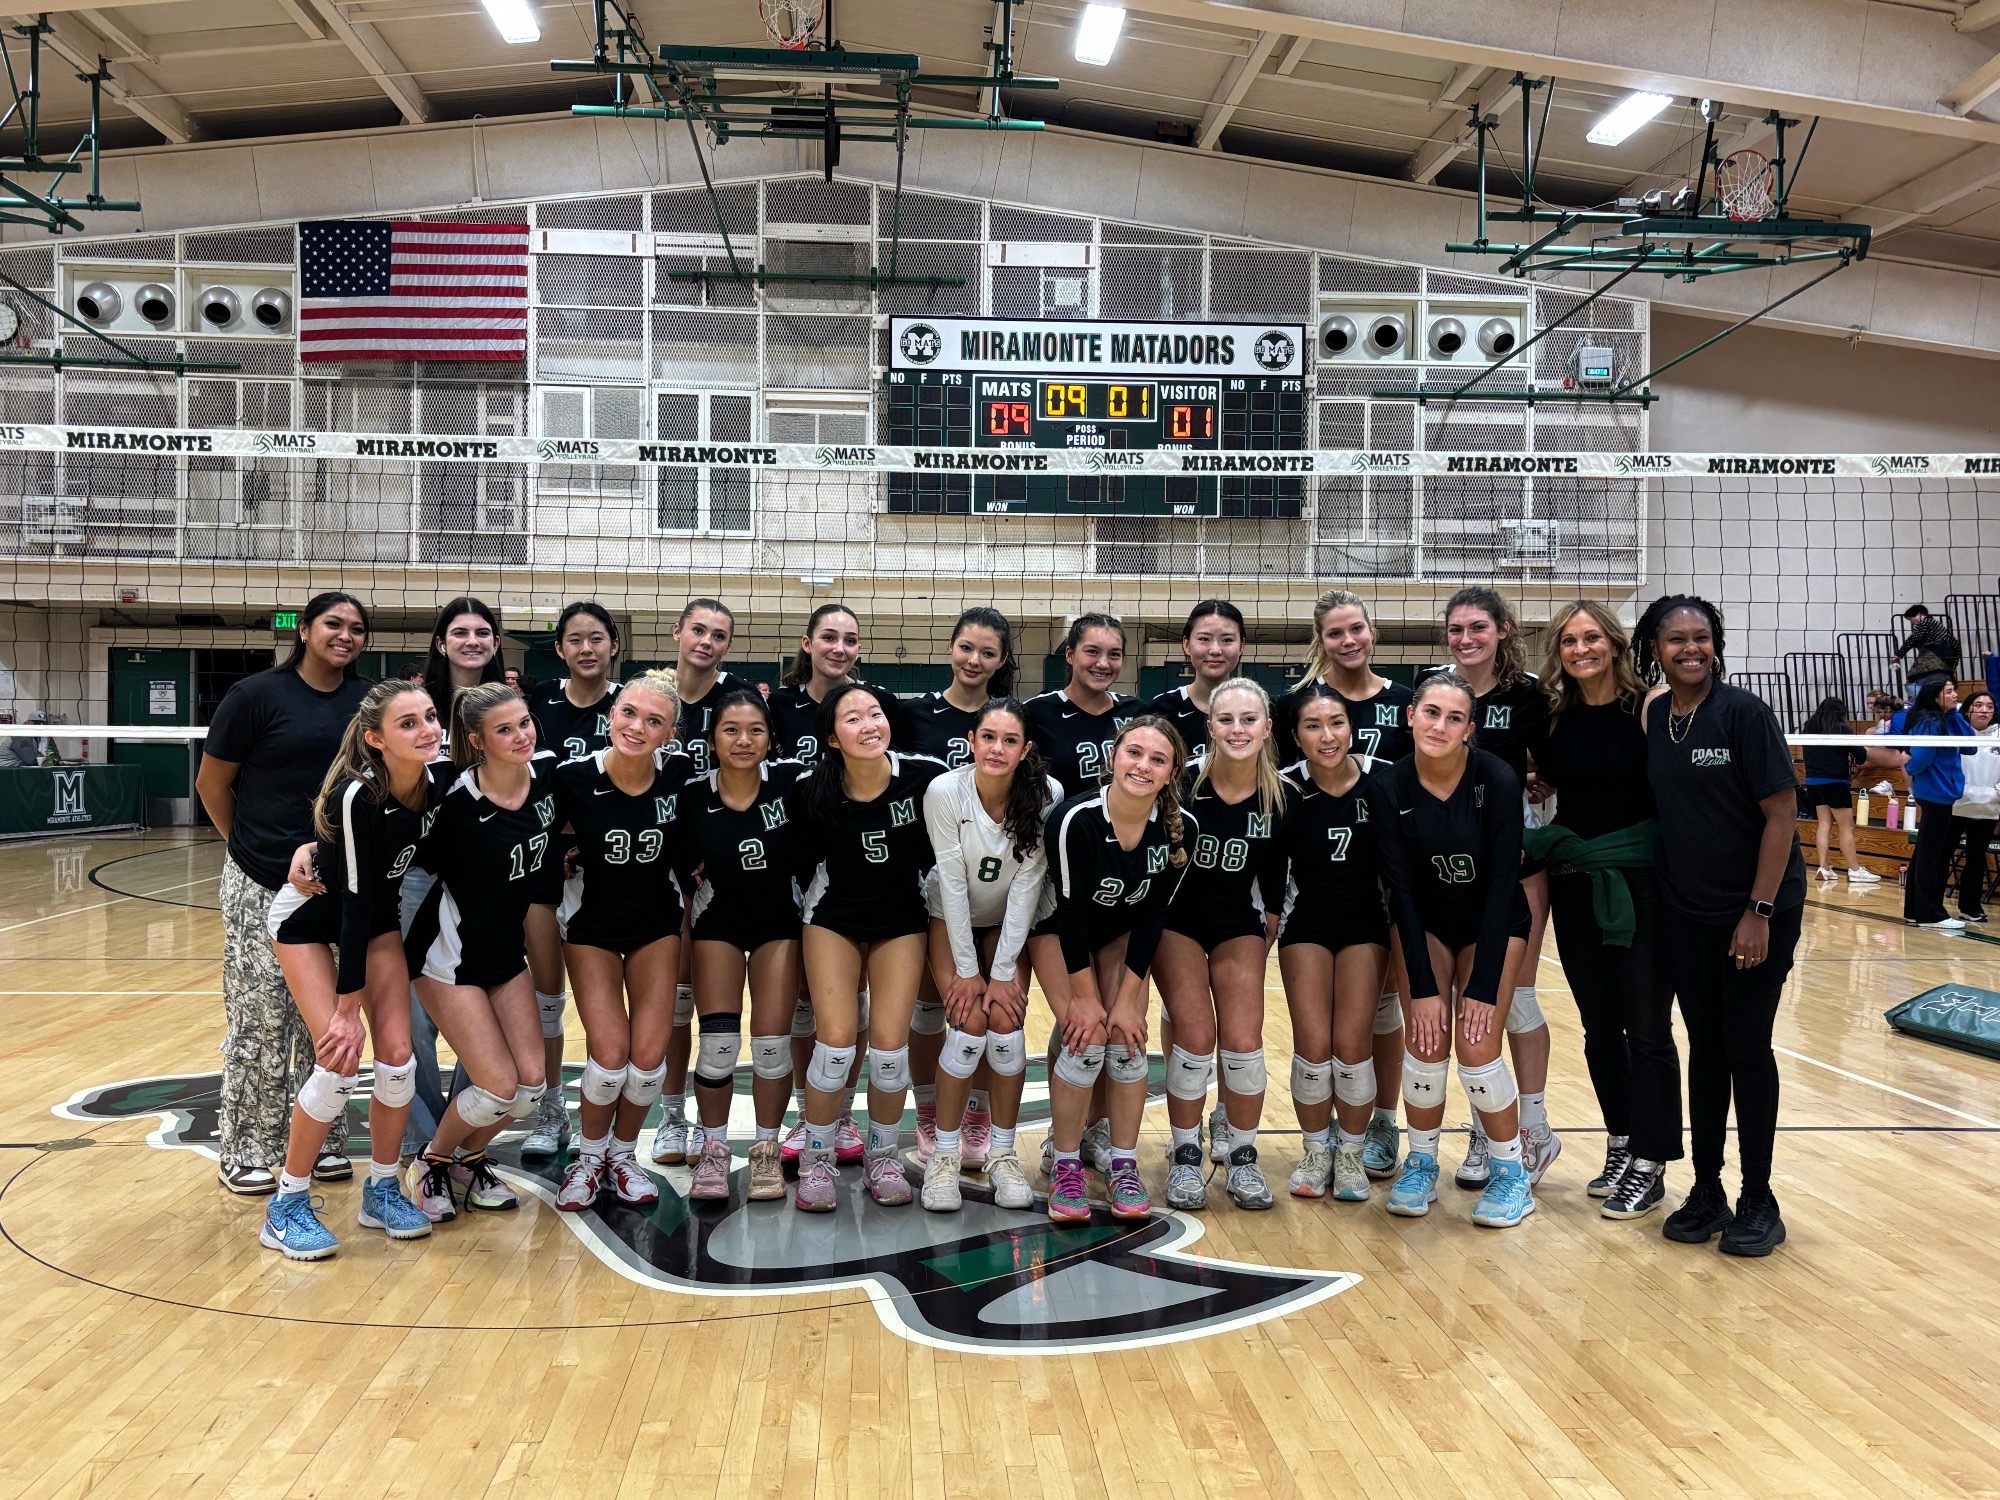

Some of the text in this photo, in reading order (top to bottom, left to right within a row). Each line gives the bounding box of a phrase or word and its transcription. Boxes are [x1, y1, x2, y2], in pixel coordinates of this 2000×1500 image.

[915, 339, 941, 347] MATS
[960, 330, 1102, 363] MIRAMONTE
[1110, 333, 1235, 366] MATADORS
[890, 373, 962, 385] NO F PTS
[1230, 379, 1301, 391] NO F PTS
[982, 382, 1031, 397] MATS
[1161, 385, 1217, 400] VISITOR
[991, 403, 1029, 435] 09
[1075, 425, 1097, 433] POSS
[1173, 407, 1211, 437] 01
[67, 431, 212, 452] MIRAMONTE
[273, 434, 316, 447] MATS
[356, 439, 497, 458] MIRAMONTE
[557, 441, 599, 454] MATS
[1066, 435, 1106, 446] PERIOD
[638, 445, 777, 465] MIRAMONTE
[834, 447, 876, 460] MATS
[913, 452, 1048, 471] MIRAMONTE
[1104, 452, 1144, 464] MATS
[1181, 455, 1314, 471] MIRAMONTE
[1369, 453, 1410, 465] MATS
[1632, 455, 1672, 467] MATS
[1890, 456, 1929, 468] MATS
[1447, 456, 1578, 473] MIRAMONTE
[1707, 458, 1836, 474] MIRAMONTE
[986, 502, 1008, 512] WON
[1173, 505, 1195, 514] WON
[275, 613, 297, 629] EXIT
[1374, 703, 1400, 728] M
[1484, 705, 1512, 730] M
[1349, 728, 1382, 757] 7
[1691, 748, 1732, 764] COACH
[52, 770, 86, 816] M
[533, 793, 556, 830] M
[655, 794, 678, 825] M
[758, 796, 789, 832] M
[889, 797, 918, 828] M
[1246, 812, 1272, 839] M
[605, 829, 664, 865] 33
[861, 830, 890, 863] 5
[1193, 834, 1249, 872] 88
[1328, 826, 1353, 862] 7
[387, 844, 417, 879] 9
[509, 832, 550, 881] 17
[739, 838, 768, 871] 2
[1147, 844, 1171, 874] M
[977, 856, 1003, 883] 8
[1431, 854, 1476, 884] 19
